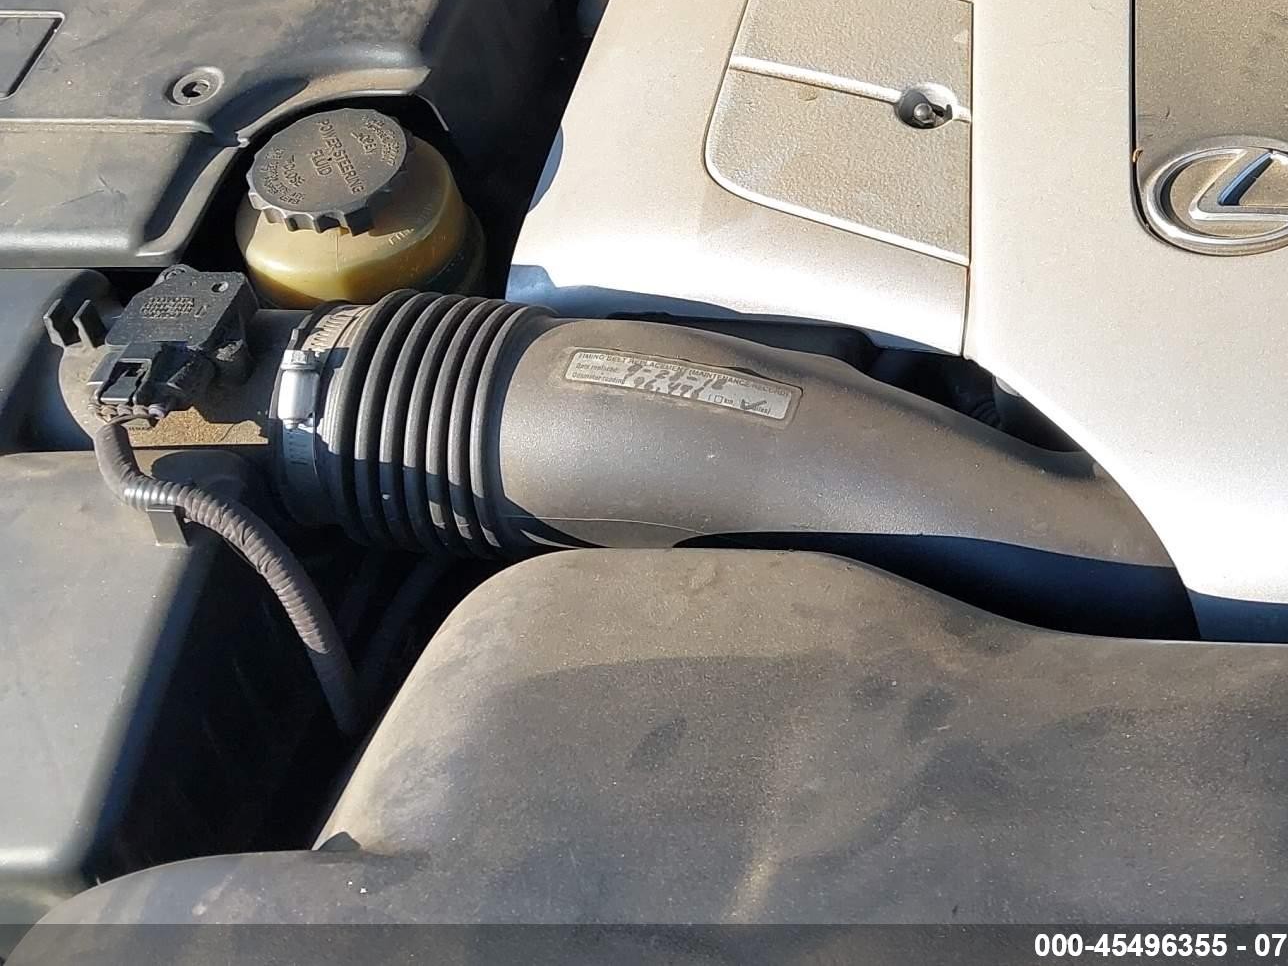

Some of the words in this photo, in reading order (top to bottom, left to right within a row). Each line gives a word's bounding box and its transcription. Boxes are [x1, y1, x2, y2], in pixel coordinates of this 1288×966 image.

[311, 149, 333, 177] FLUID
[316, 118, 343, 154] POWER
[332, 149, 364, 195] STEERING
